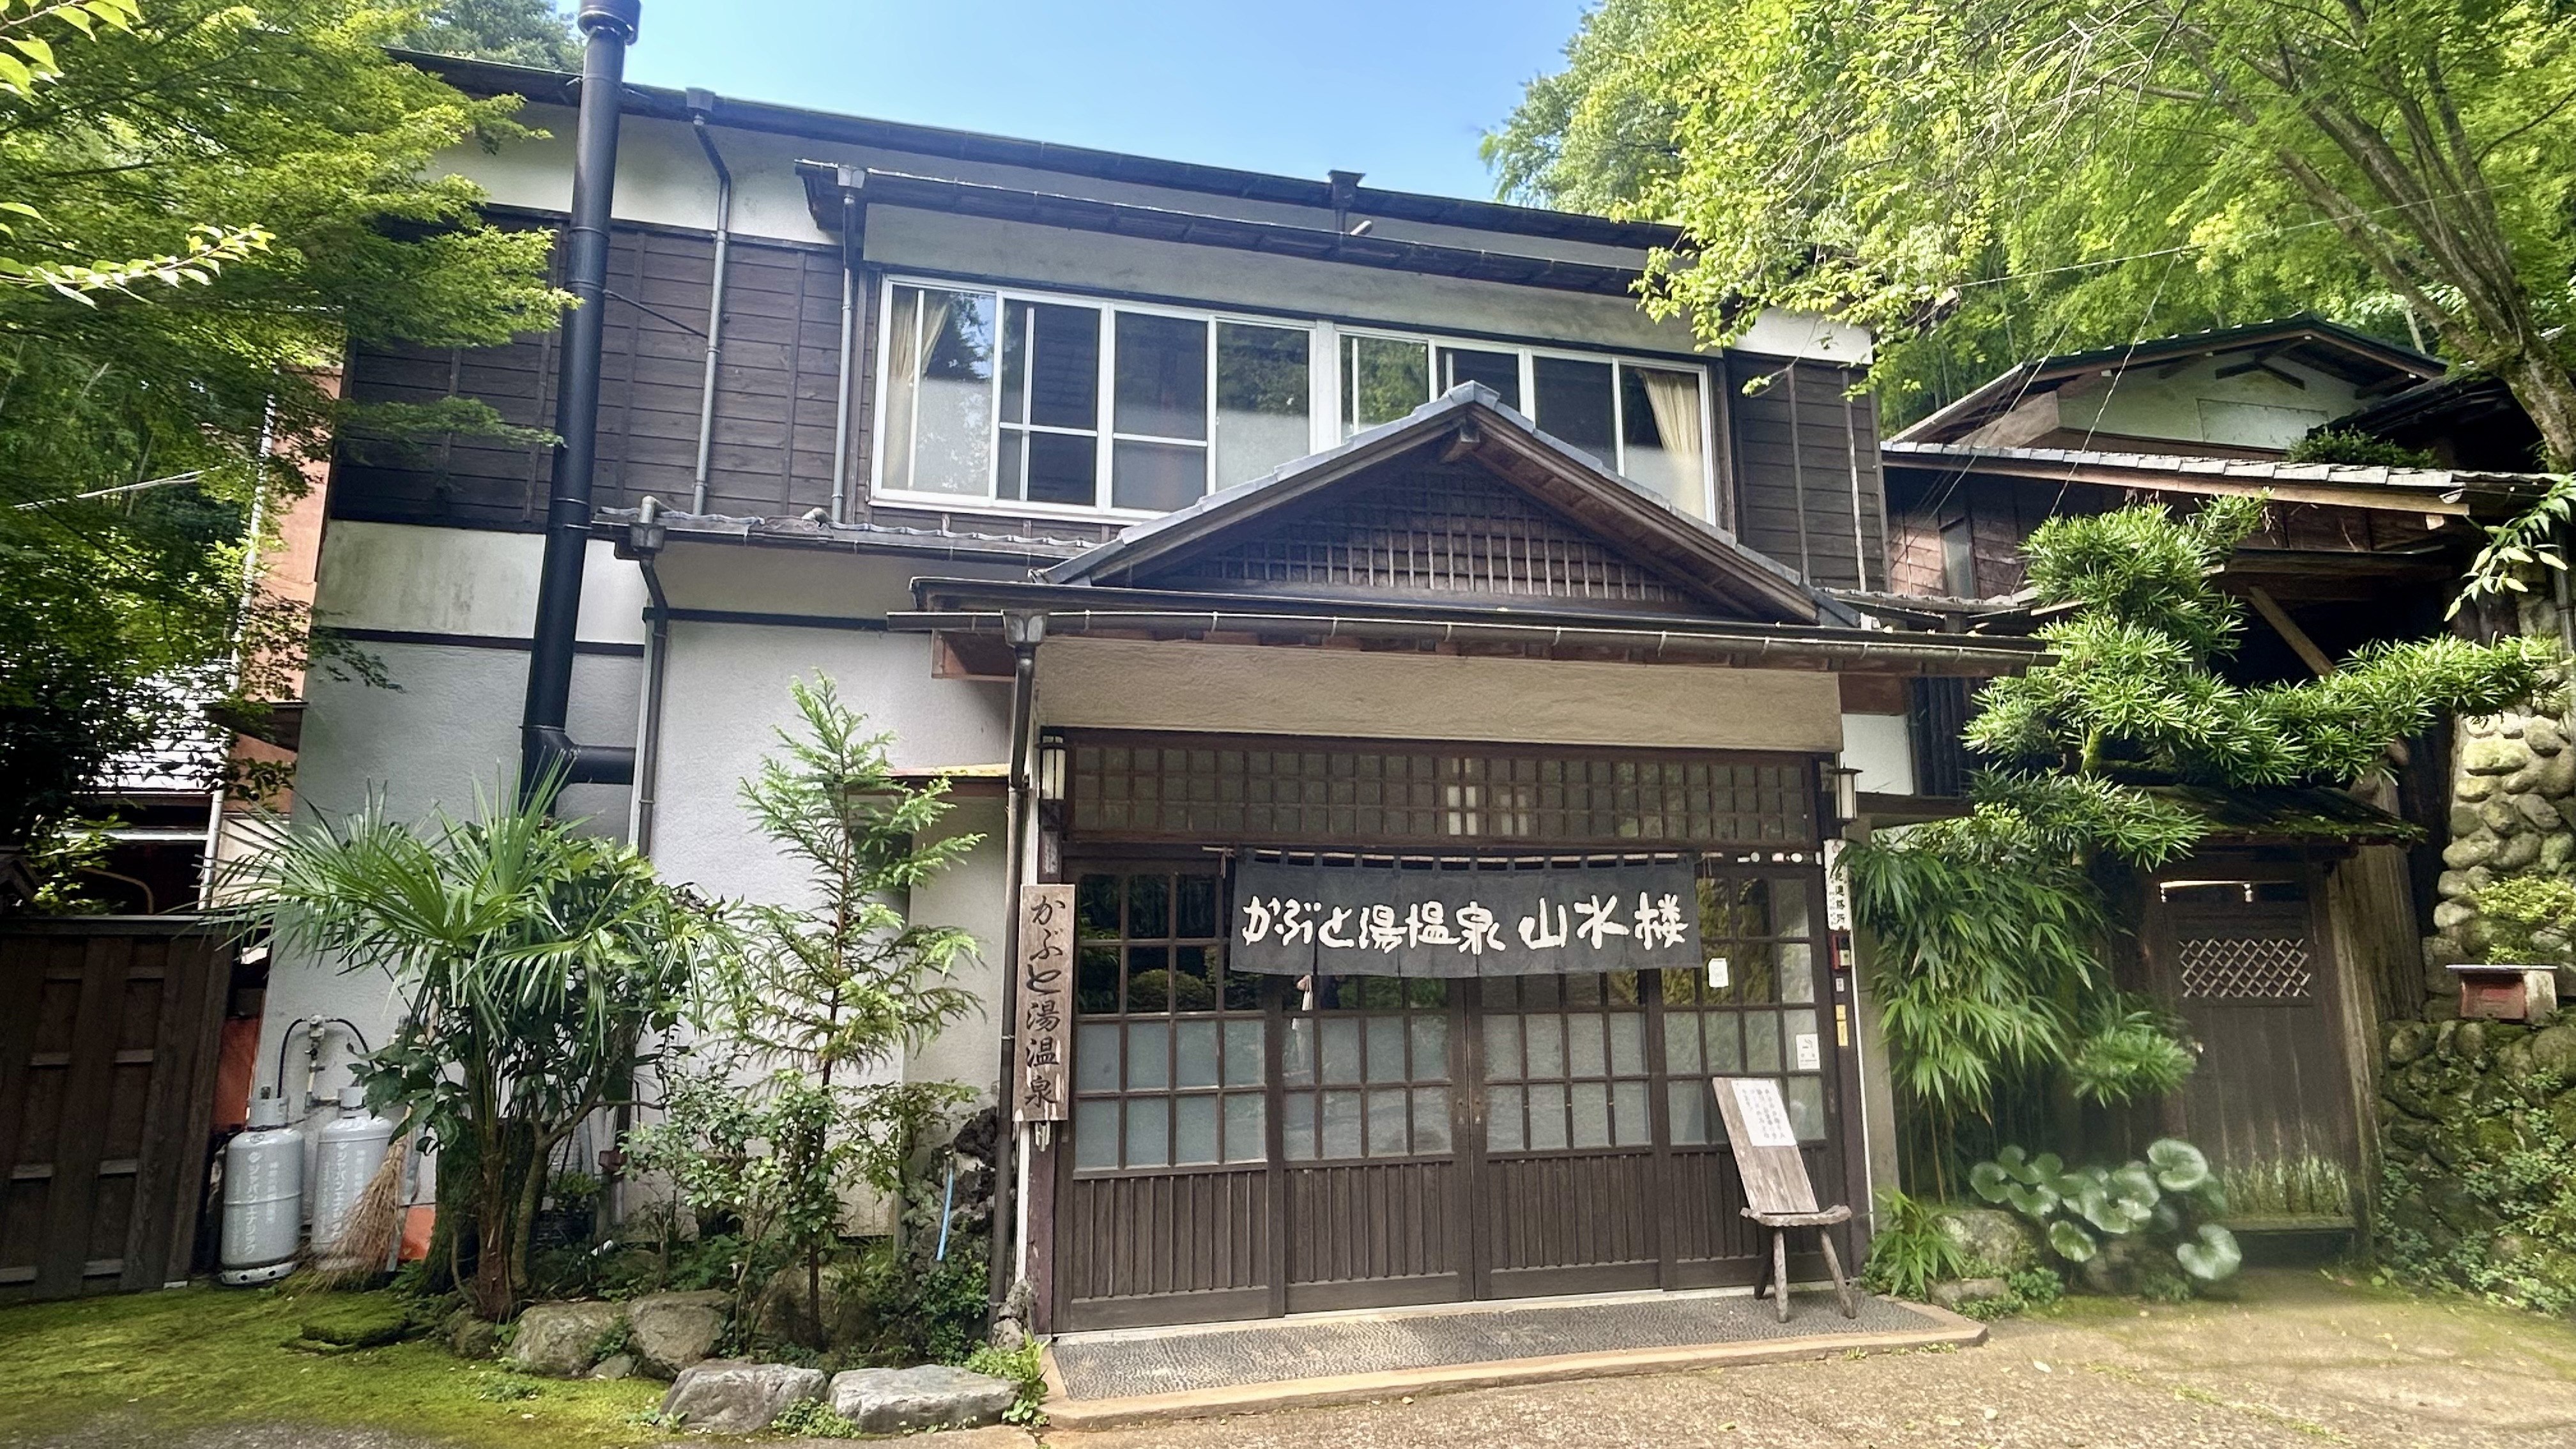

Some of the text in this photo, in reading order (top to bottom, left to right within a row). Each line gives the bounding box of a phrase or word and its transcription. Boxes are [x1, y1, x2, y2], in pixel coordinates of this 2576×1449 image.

[1241, 892, 1689, 954] かぶと湯温泉 山水楼
[1024, 894, 1066, 1108] かぶと湯温泉
